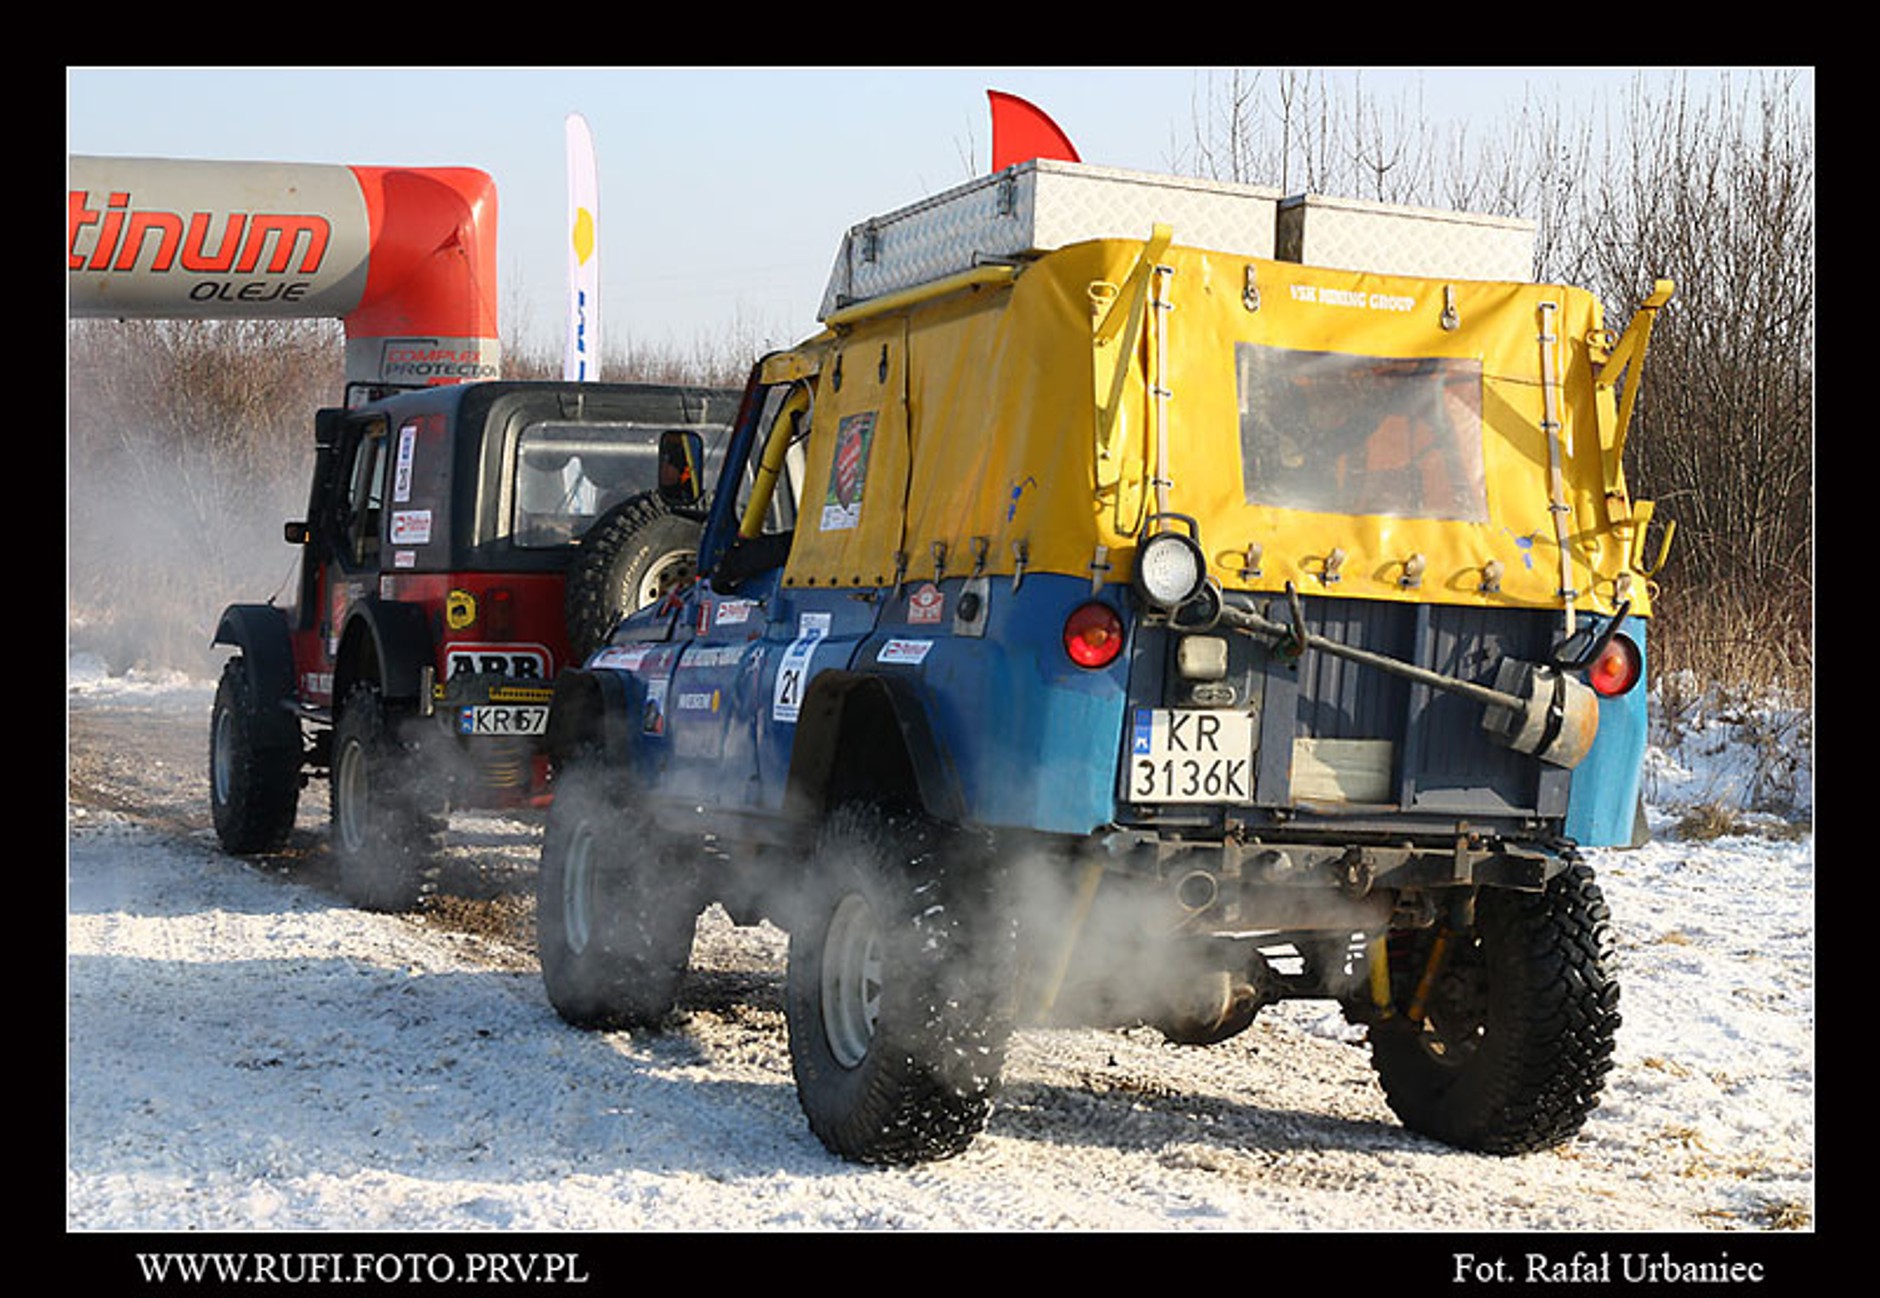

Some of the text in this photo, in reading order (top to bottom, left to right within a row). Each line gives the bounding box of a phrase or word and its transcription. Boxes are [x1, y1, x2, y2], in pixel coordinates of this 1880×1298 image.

[69, 190, 331, 274] tinum
[189, 282, 310, 302] OLEJE
[1370, 294, 1415, 311] GROUP
[779, 669, 801, 705] 21
[476, 709, 511, 732] KR
[1167, 711, 1221, 752] KR
[1136, 758, 1247, 797] 3136K
